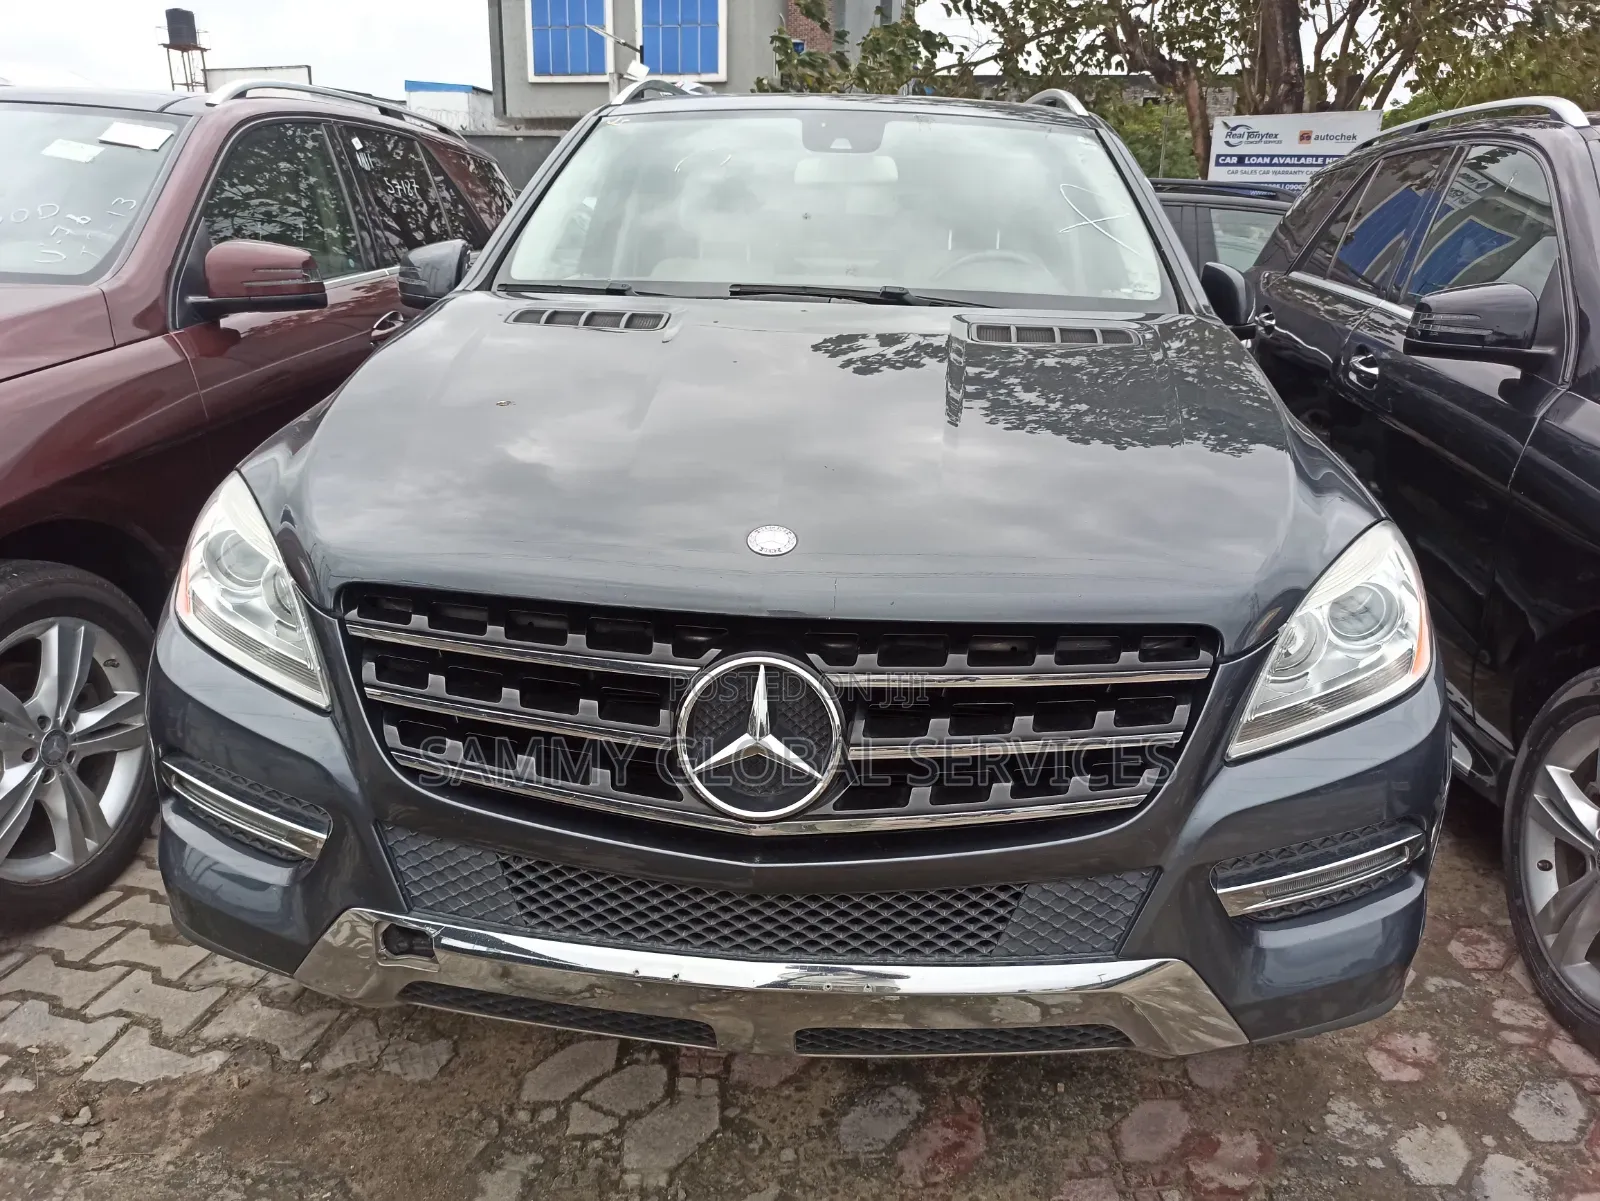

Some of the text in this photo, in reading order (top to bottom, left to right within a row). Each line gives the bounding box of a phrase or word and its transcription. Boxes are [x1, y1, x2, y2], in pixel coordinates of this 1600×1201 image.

[1225, 131, 1279, 141] Real Tonytex
[1314, 133, 1357, 141] autochek
[1272, 157, 1324, 165] AVAILABLE
